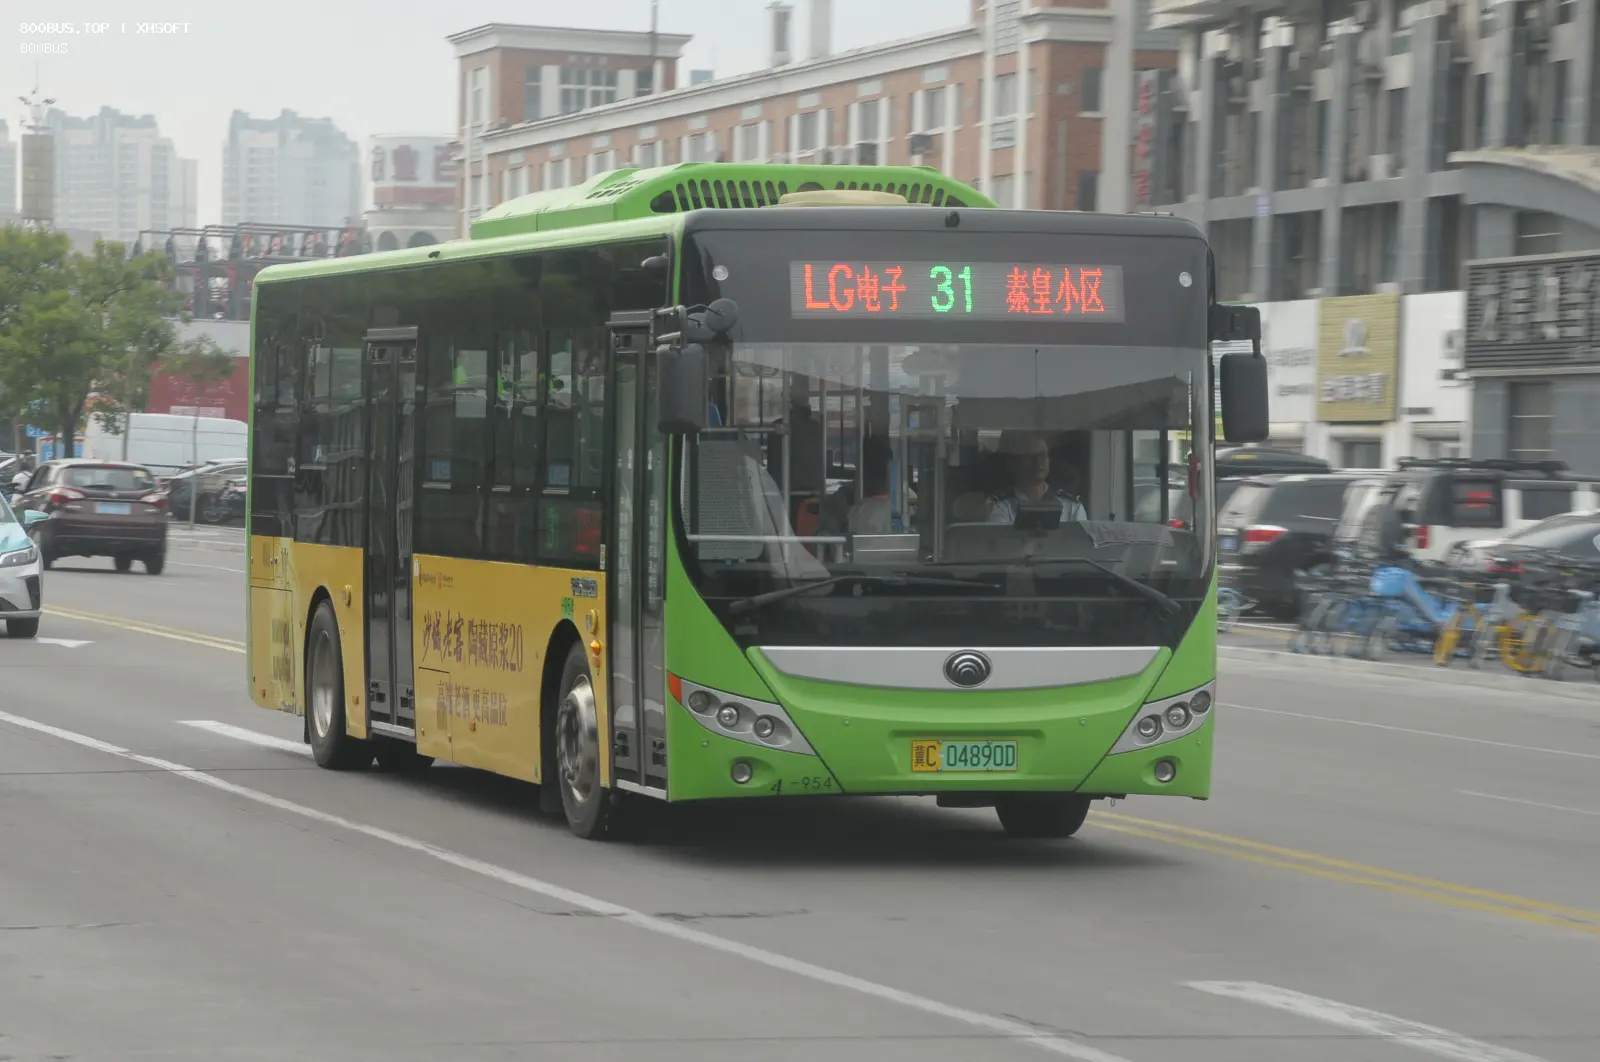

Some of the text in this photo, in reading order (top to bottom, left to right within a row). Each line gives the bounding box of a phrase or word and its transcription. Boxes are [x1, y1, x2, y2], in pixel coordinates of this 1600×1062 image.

[803, 263, 1105, 314] LG电子 31 秦皇小区
